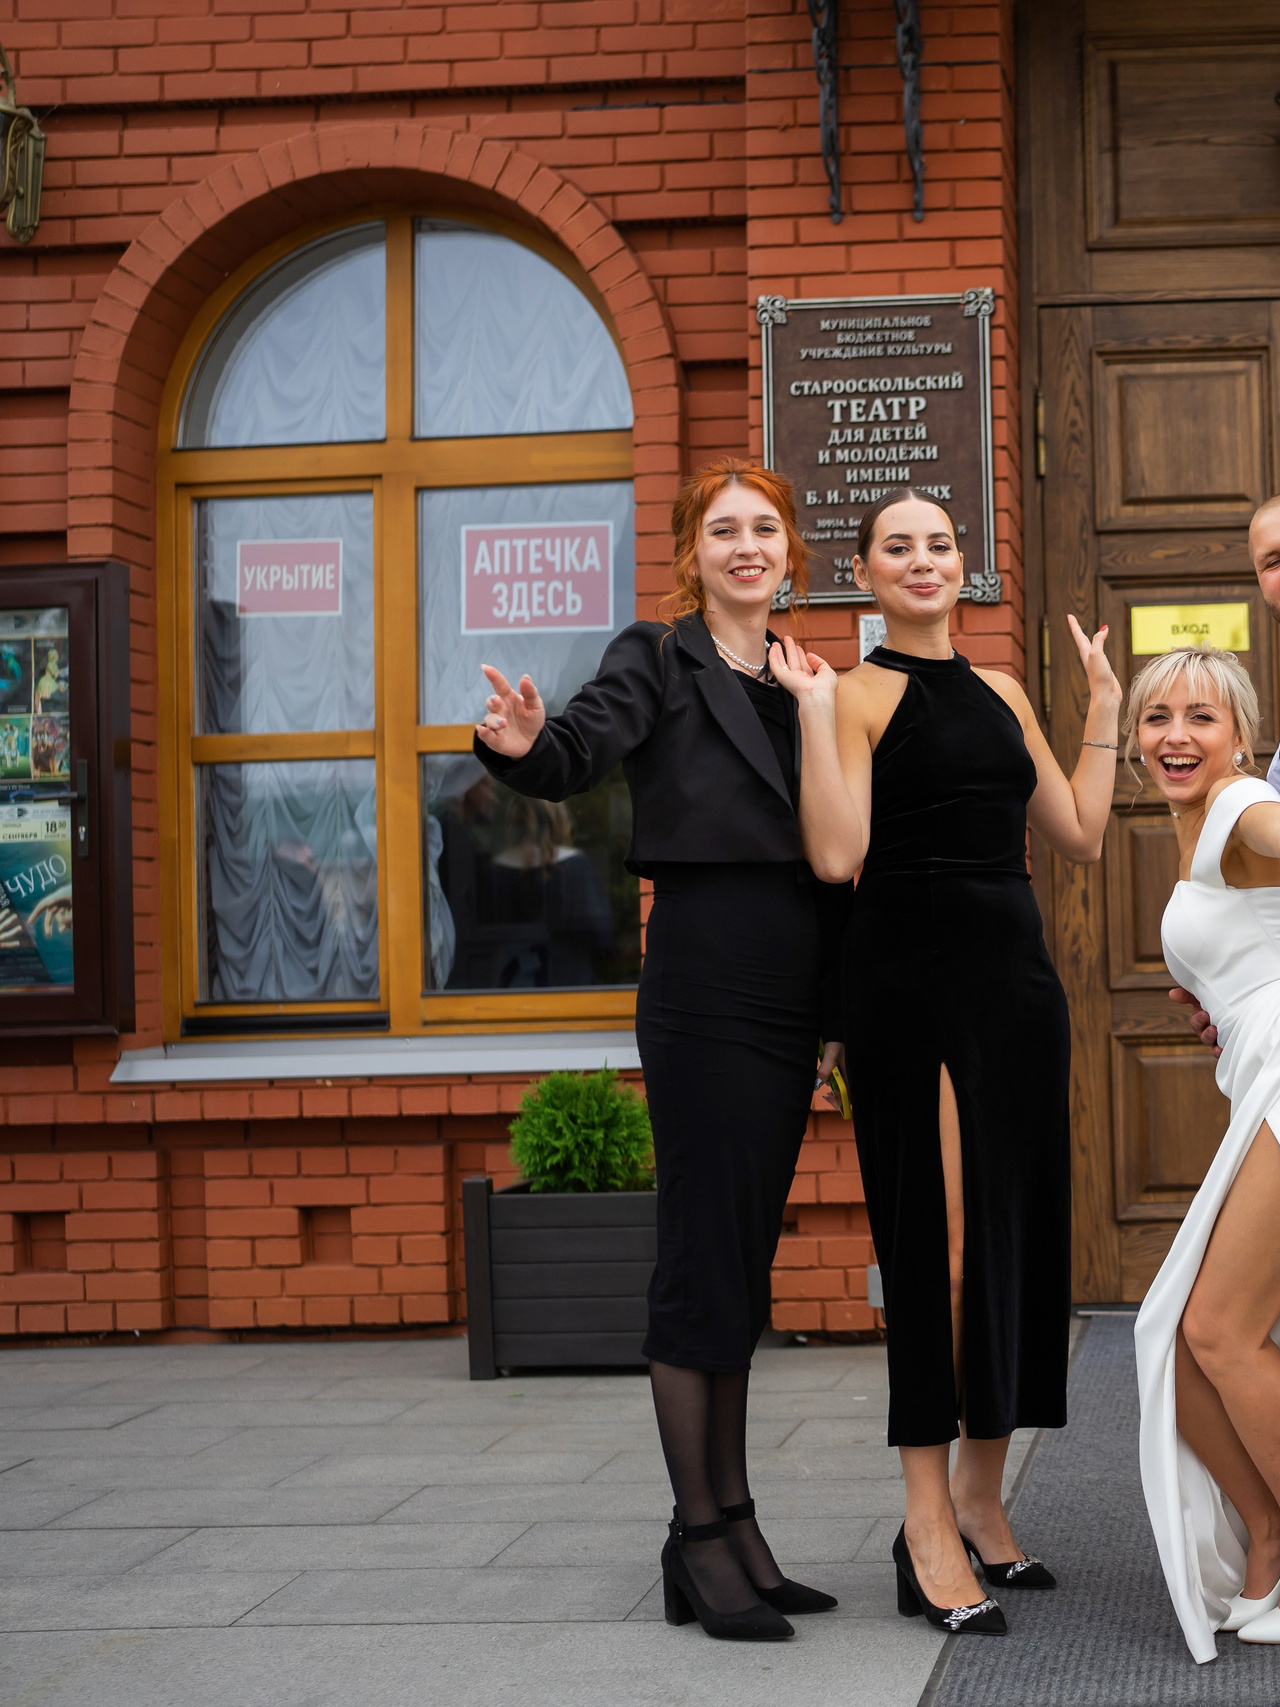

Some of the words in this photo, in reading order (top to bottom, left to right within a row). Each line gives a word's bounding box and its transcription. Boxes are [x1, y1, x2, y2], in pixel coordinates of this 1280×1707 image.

[820, 315, 932, 331] МУНИЦИПАЛЬНОЕ
[836, 330, 916, 345] БЮДЖЕТНОЕ
[800, 345, 884, 360] УЧРЕЖДЕНИЕ
[887, 343, 953, 356] КУЛЬТУРЫ
[790, 371, 963, 396] СТАРООСКОЛЬСКИЙ
[827, 396, 927, 424] ТЕАТР
[827, 427, 865, 446] ДЛЯ
[869, 422, 927, 445] ДЕТЕЙ
[818, 449, 831, 465] И
[835, 444, 938, 464] МОЛОДЁЖИ
[846, 466, 911, 484] ИМЕНИ
[806, 490, 822, 506] Б.
[826, 489, 844, 505] И.
[473, 536, 601, 577] АПТЕЧКА
[243, 563, 336, 592] УКРЫТИЕ
[492, 580, 583, 624] ЗДЕСЬ
[1171, 623, 1210, 635] ВХОД
[5, 853, 67, 898] ЧУДО
